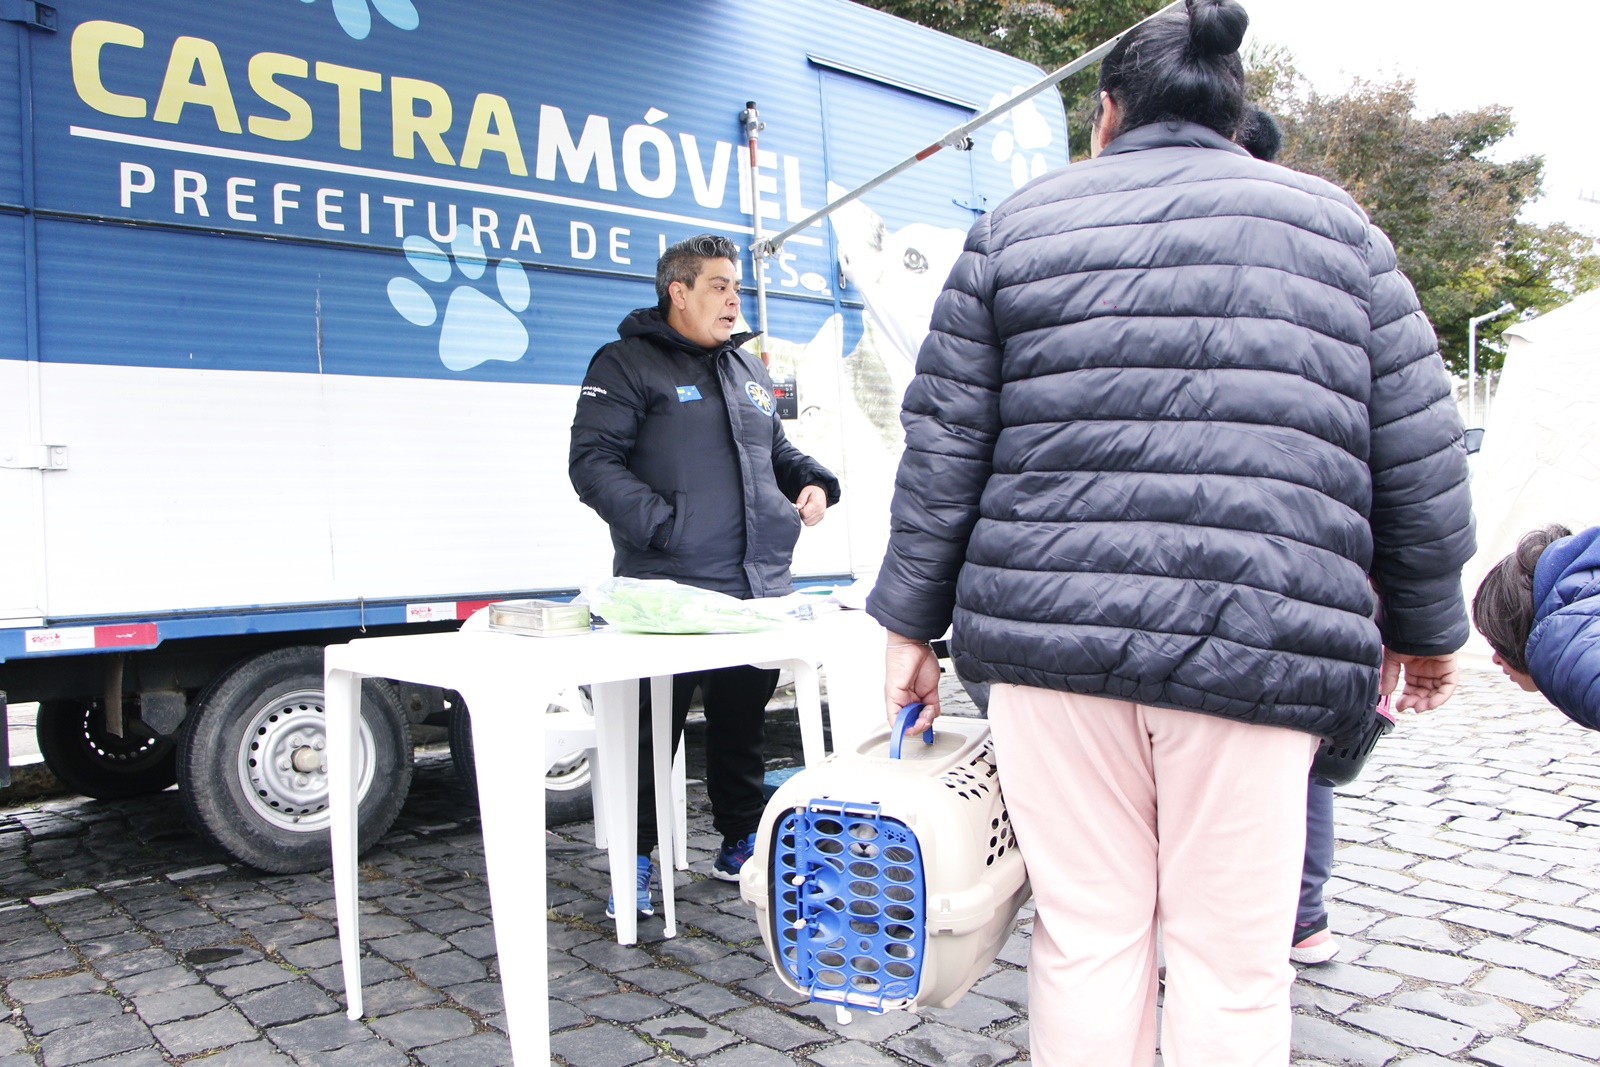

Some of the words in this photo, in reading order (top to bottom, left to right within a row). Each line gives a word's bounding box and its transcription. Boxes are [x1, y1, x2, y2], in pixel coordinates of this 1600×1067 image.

[71, 20, 822, 227] CASTRAMÓVEL
[120, 162, 541, 255] PREFEITURA
[571, 222, 631, 264] DE
